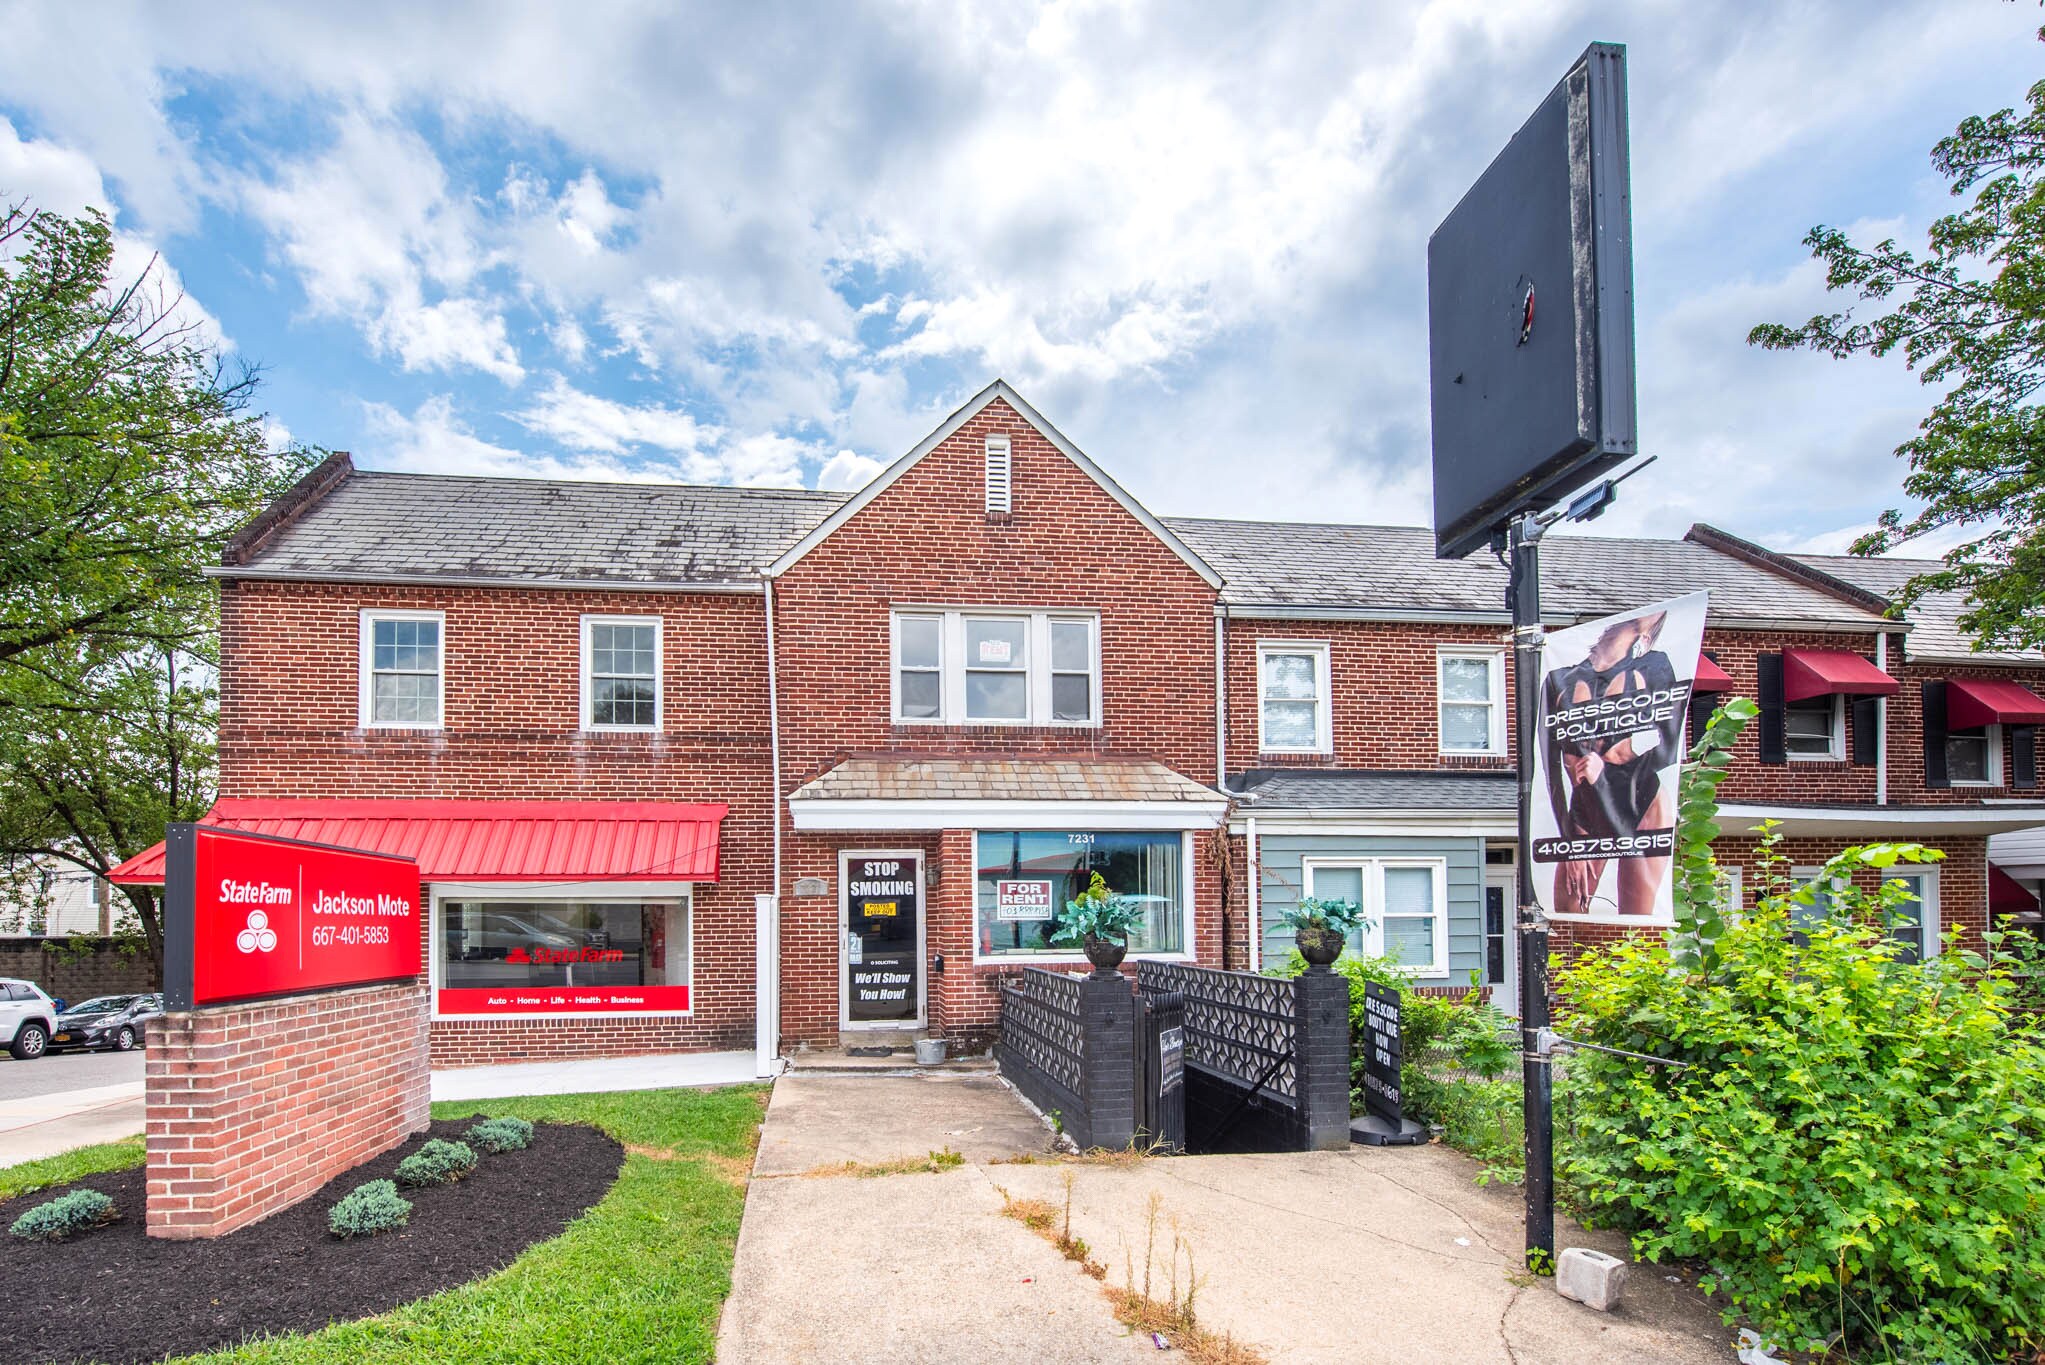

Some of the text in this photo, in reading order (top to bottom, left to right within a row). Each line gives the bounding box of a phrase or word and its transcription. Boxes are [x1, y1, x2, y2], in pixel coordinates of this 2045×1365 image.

[1545, 685, 1689, 728] DRESSCODE
[1556, 706, 1674, 741] BOUTIQUE
[1067, 834, 1095, 844] 7231
[1538, 833, 1672, 855] 410.575.3615
[864, 861, 900, 876] STOP
[850, 881, 914, 896] SMOKING
[1007, 883, 1041, 894] FOR
[312, 889, 410, 917] Jackson Mote
[1002, 894, 1047, 904] RENT
[312, 926, 389, 946] 667-401-5853
[855, 972, 911, 984] We'll Show
[488, 997, 507, 1005] Auto
[550, 996, 565, 1004] Life
[575, 996, 601, 1004] Health
[610, 996, 644, 1004] Business
[860, 988, 906, 1001] You How!
[1375, 1032, 1389, 1050] NOW
[1376, 1047, 1391, 1067] OPEN
